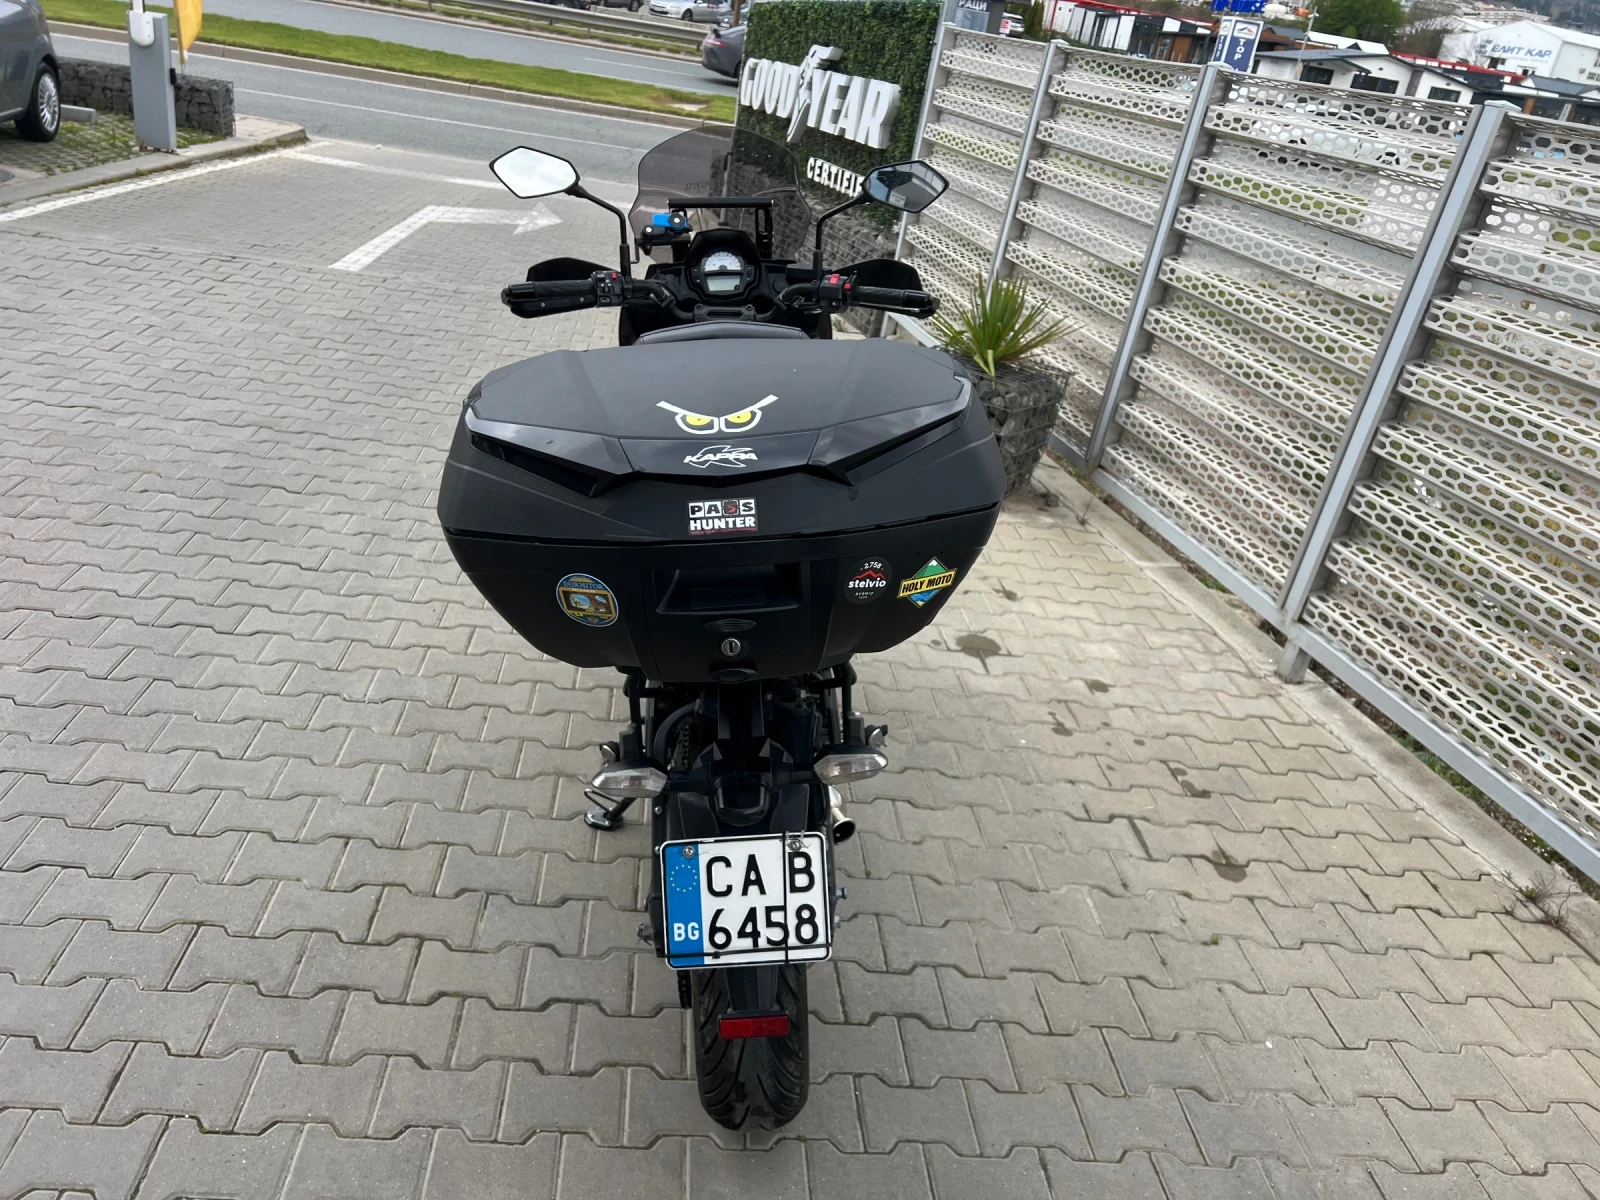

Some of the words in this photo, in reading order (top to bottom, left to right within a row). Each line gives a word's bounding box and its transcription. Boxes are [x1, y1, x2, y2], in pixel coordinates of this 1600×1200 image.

[1234, 39, 1246, 60] TOP
[1491, 44, 1524, 54] ЕЛИТ
[1526, 48, 1552, 57] КАР
[684, 452, 758, 463] KAPPA
[690, 516, 755, 530] HUNTER
[848, 578, 886, 588] stelvio
[901, 580, 925, 594] HOLY
[926, 573, 953, 588] MOTO
[673, 921, 700, 942] BG
[708, 903, 819, 949] 6458
